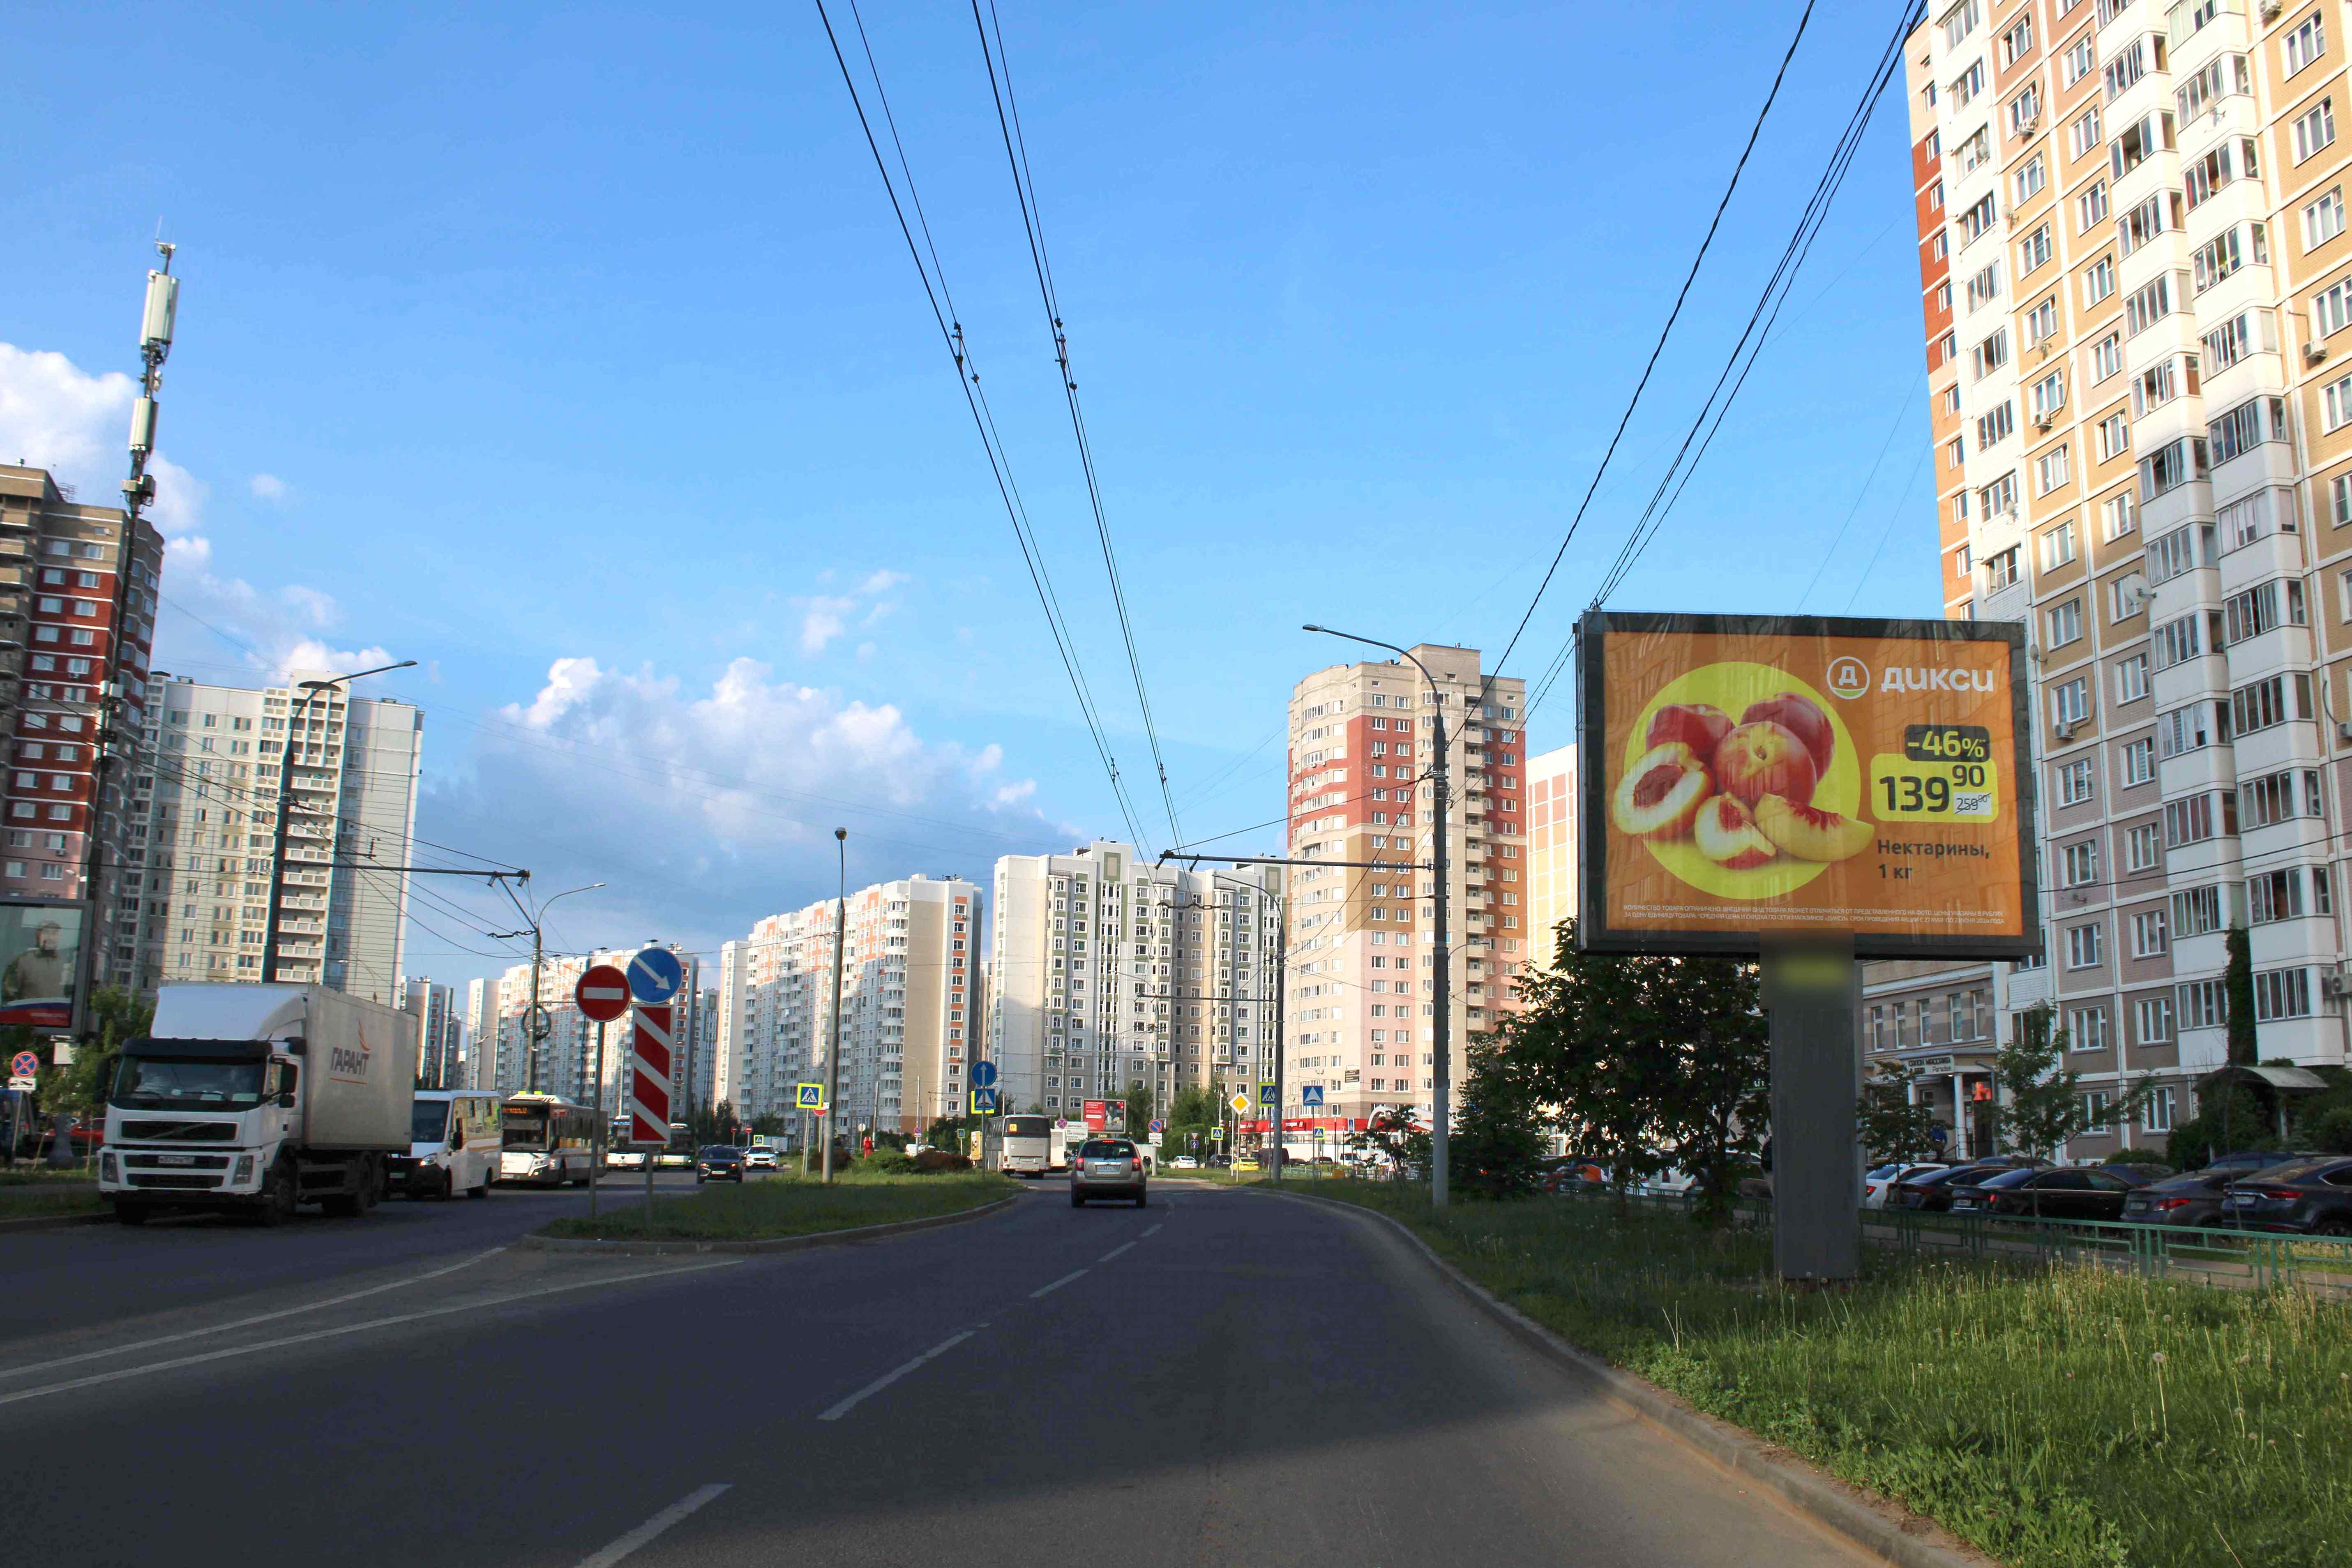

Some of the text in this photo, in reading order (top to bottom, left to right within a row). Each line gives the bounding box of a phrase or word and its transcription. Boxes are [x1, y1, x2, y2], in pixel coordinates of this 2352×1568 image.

[1879, 764, 1985, 812] 139 90
[1877, 839, 1990, 859] Нектарины,
[1879, 864, 1913, 879] 1 кг
[330, 1046, 369, 1076] ГАРАНТ
